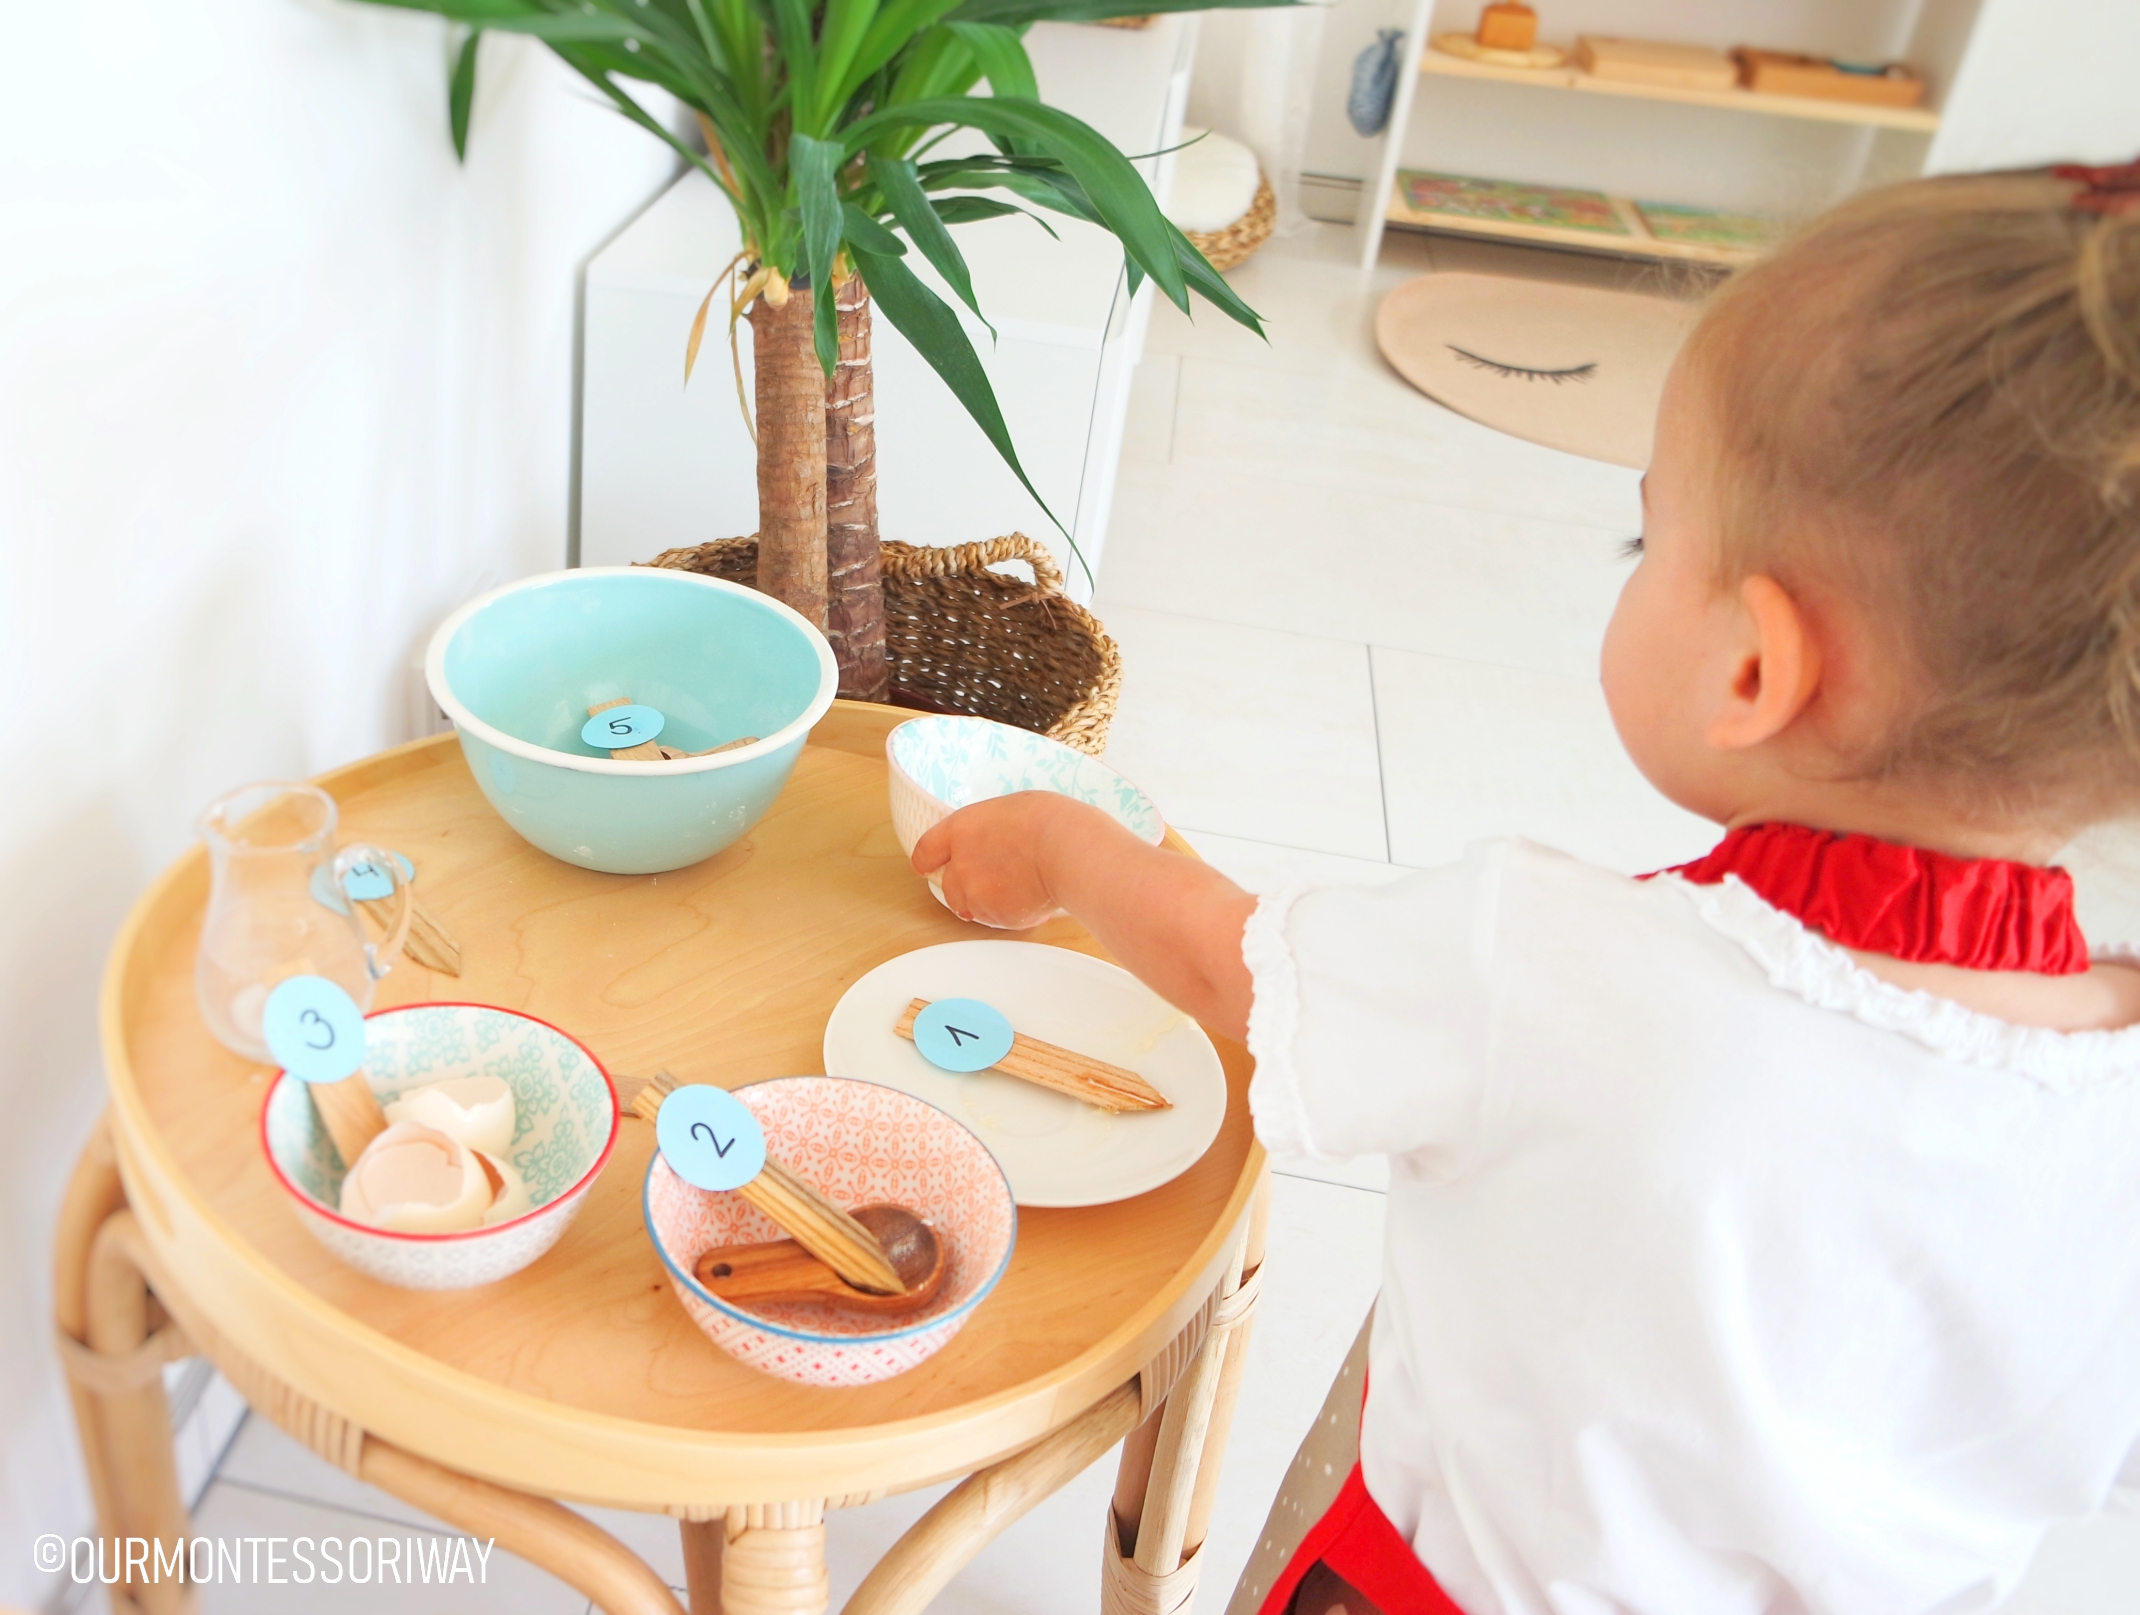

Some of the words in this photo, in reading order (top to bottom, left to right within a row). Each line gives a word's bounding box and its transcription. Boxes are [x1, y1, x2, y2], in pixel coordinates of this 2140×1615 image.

[608, 716, 633, 735] 5
[299, 1008, 336, 1051] 3
[943, 1024, 981, 1048] 1
[690, 1121, 736, 1159] 2
